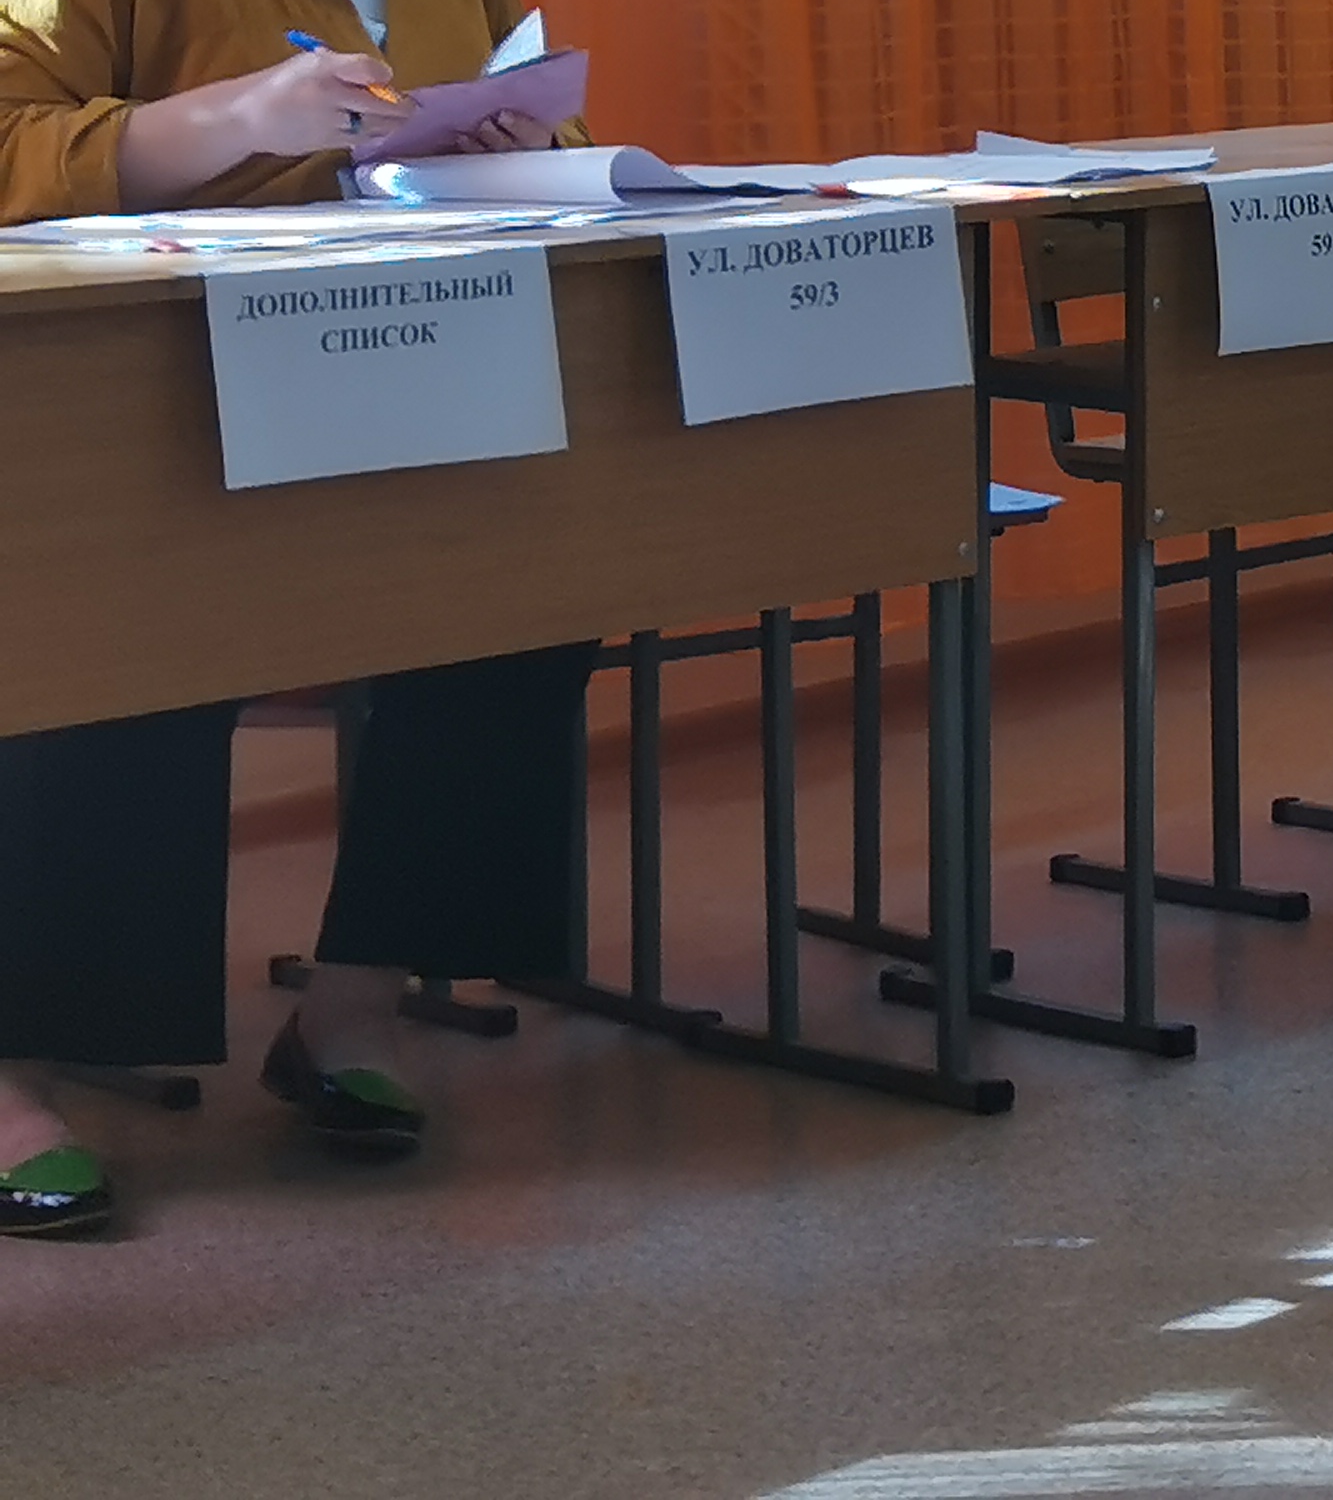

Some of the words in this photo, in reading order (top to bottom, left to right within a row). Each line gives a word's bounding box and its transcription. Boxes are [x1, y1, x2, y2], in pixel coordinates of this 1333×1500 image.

[1229, 197, 1270, 224] УЛ.
[687, 247, 737, 277] УЛ.
[743, 224, 935, 275] ДОВАТОРЦЕВ
[236, 269, 514, 323] ДОПОЛНИТЕЛЬНЫЙ
[790, 281, 840, 311] 59/3
[320, 321, 439, 354] СПИСОК
